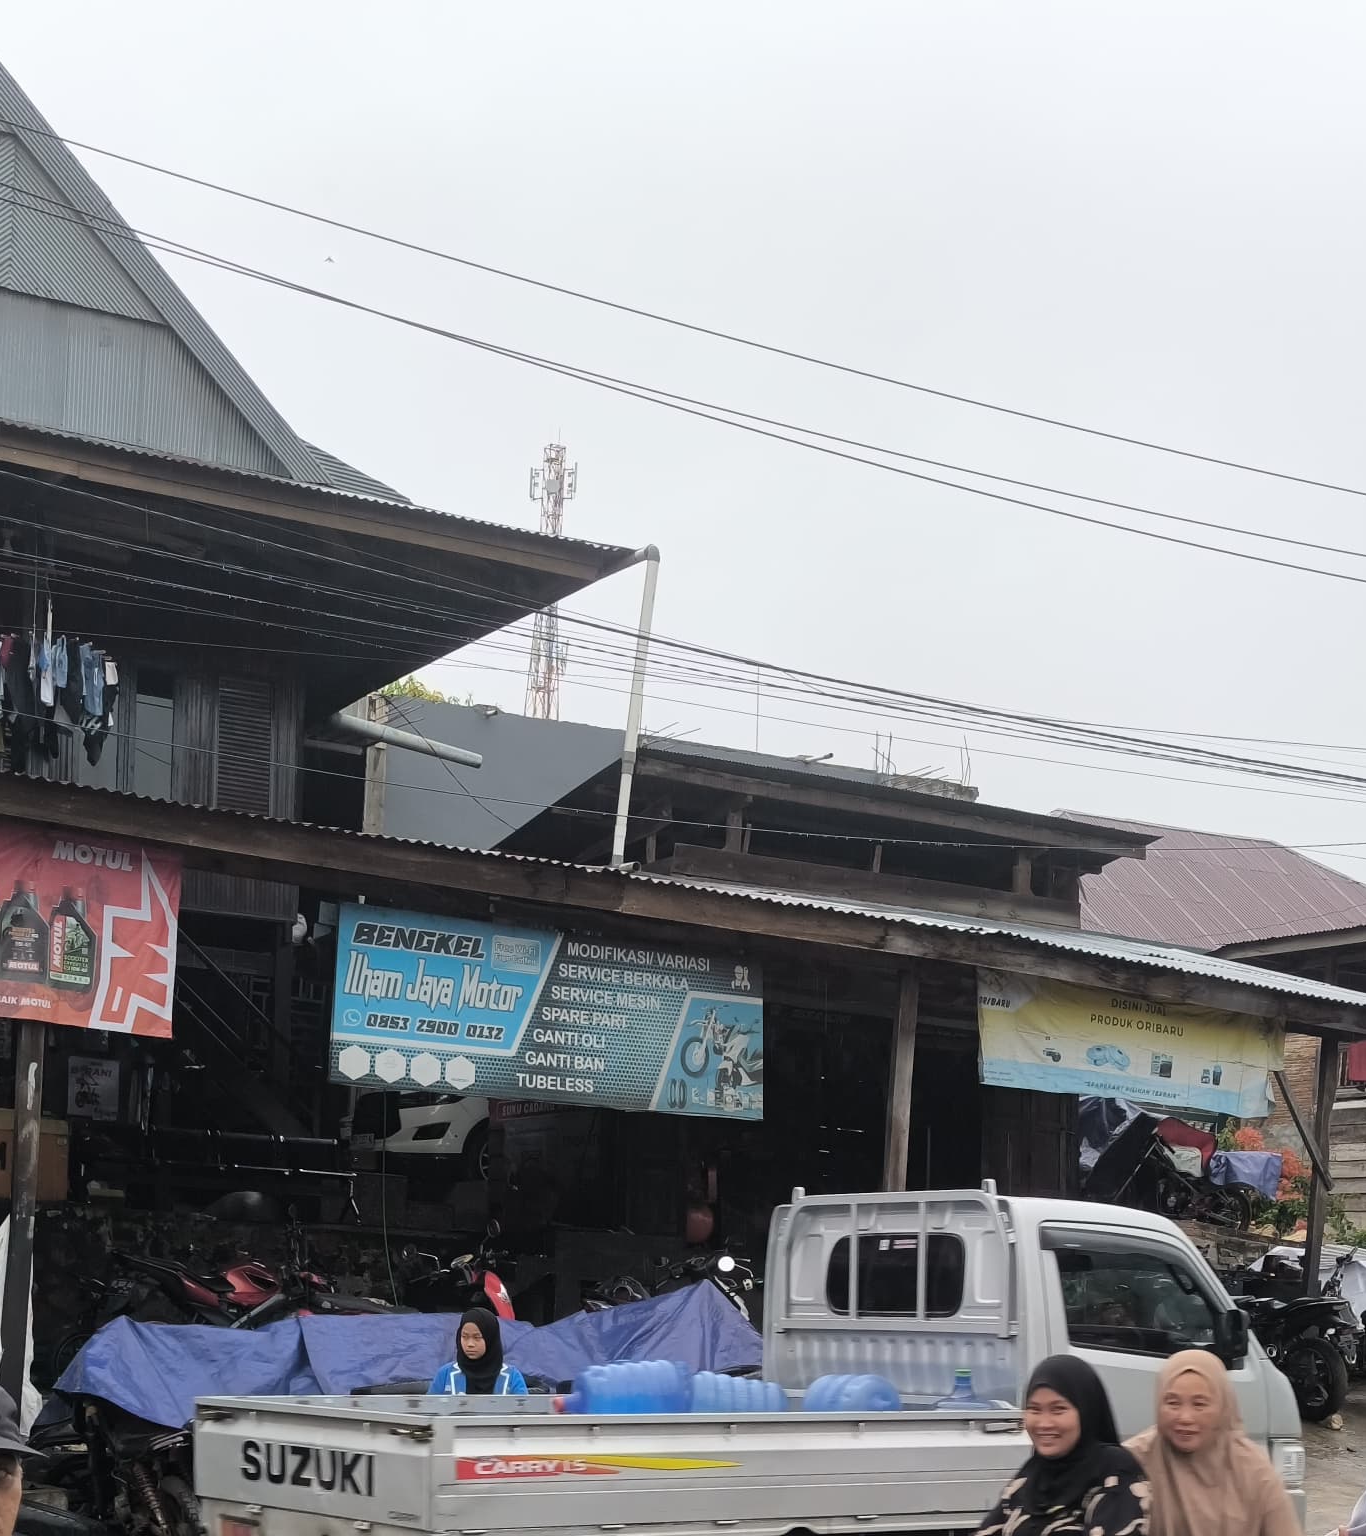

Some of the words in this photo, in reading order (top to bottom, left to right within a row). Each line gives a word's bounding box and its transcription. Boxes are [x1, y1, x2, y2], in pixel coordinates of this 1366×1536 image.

[52, 840, 134, 872] MOTUL
[52, 920, 64, 968] MOTUL
[352, 921, 486, 960] BENGKEL
[568, 942, 653, 966] MODIFIKASI/
[658, 953, 710, 972] VARIASI
[344, 951, 404, 1007] Ilham
[406, 959, 455, 1013] Jaya
[456, 963, 523, 1016] Motor
[558, 963, 620, 984] SERVICE
[623, 970, 688, 990] BERKALA
[21, 996, 52, 1009] MOTUL
[551, 985, 614, 1004] SERVICE
[617, 993, 660, 1010] MESIN
[1111, 997, 1142, 1014] DISINI
[1145, 1003, 1167, 1017] JUAL
[366, 1013, 411, 1032] 0853
[416, 1018, 460, 1037] 2900
[465, 1024, 505, 1042] 0132
[541, 1006, 588, 1026] SPARE
[592, 1011, 629, 1029] PART
[1090, 1013, 1133, 1030] PRODUK
[1136, 1018, 1184, 1038] ORIBARU
[533, 1028, 578, 1047] GANTI
[581, 1032, 606, 1050] OLI
[525, 1050, 570, 1070] GANTI
[574, 1054, 605, 1073] BAN
[516, 1072, 594, 1094] TUBELESS
[240, 1438, 377, 1498] SUZUKI
[474, 1460, 561, 1476] CARRY
